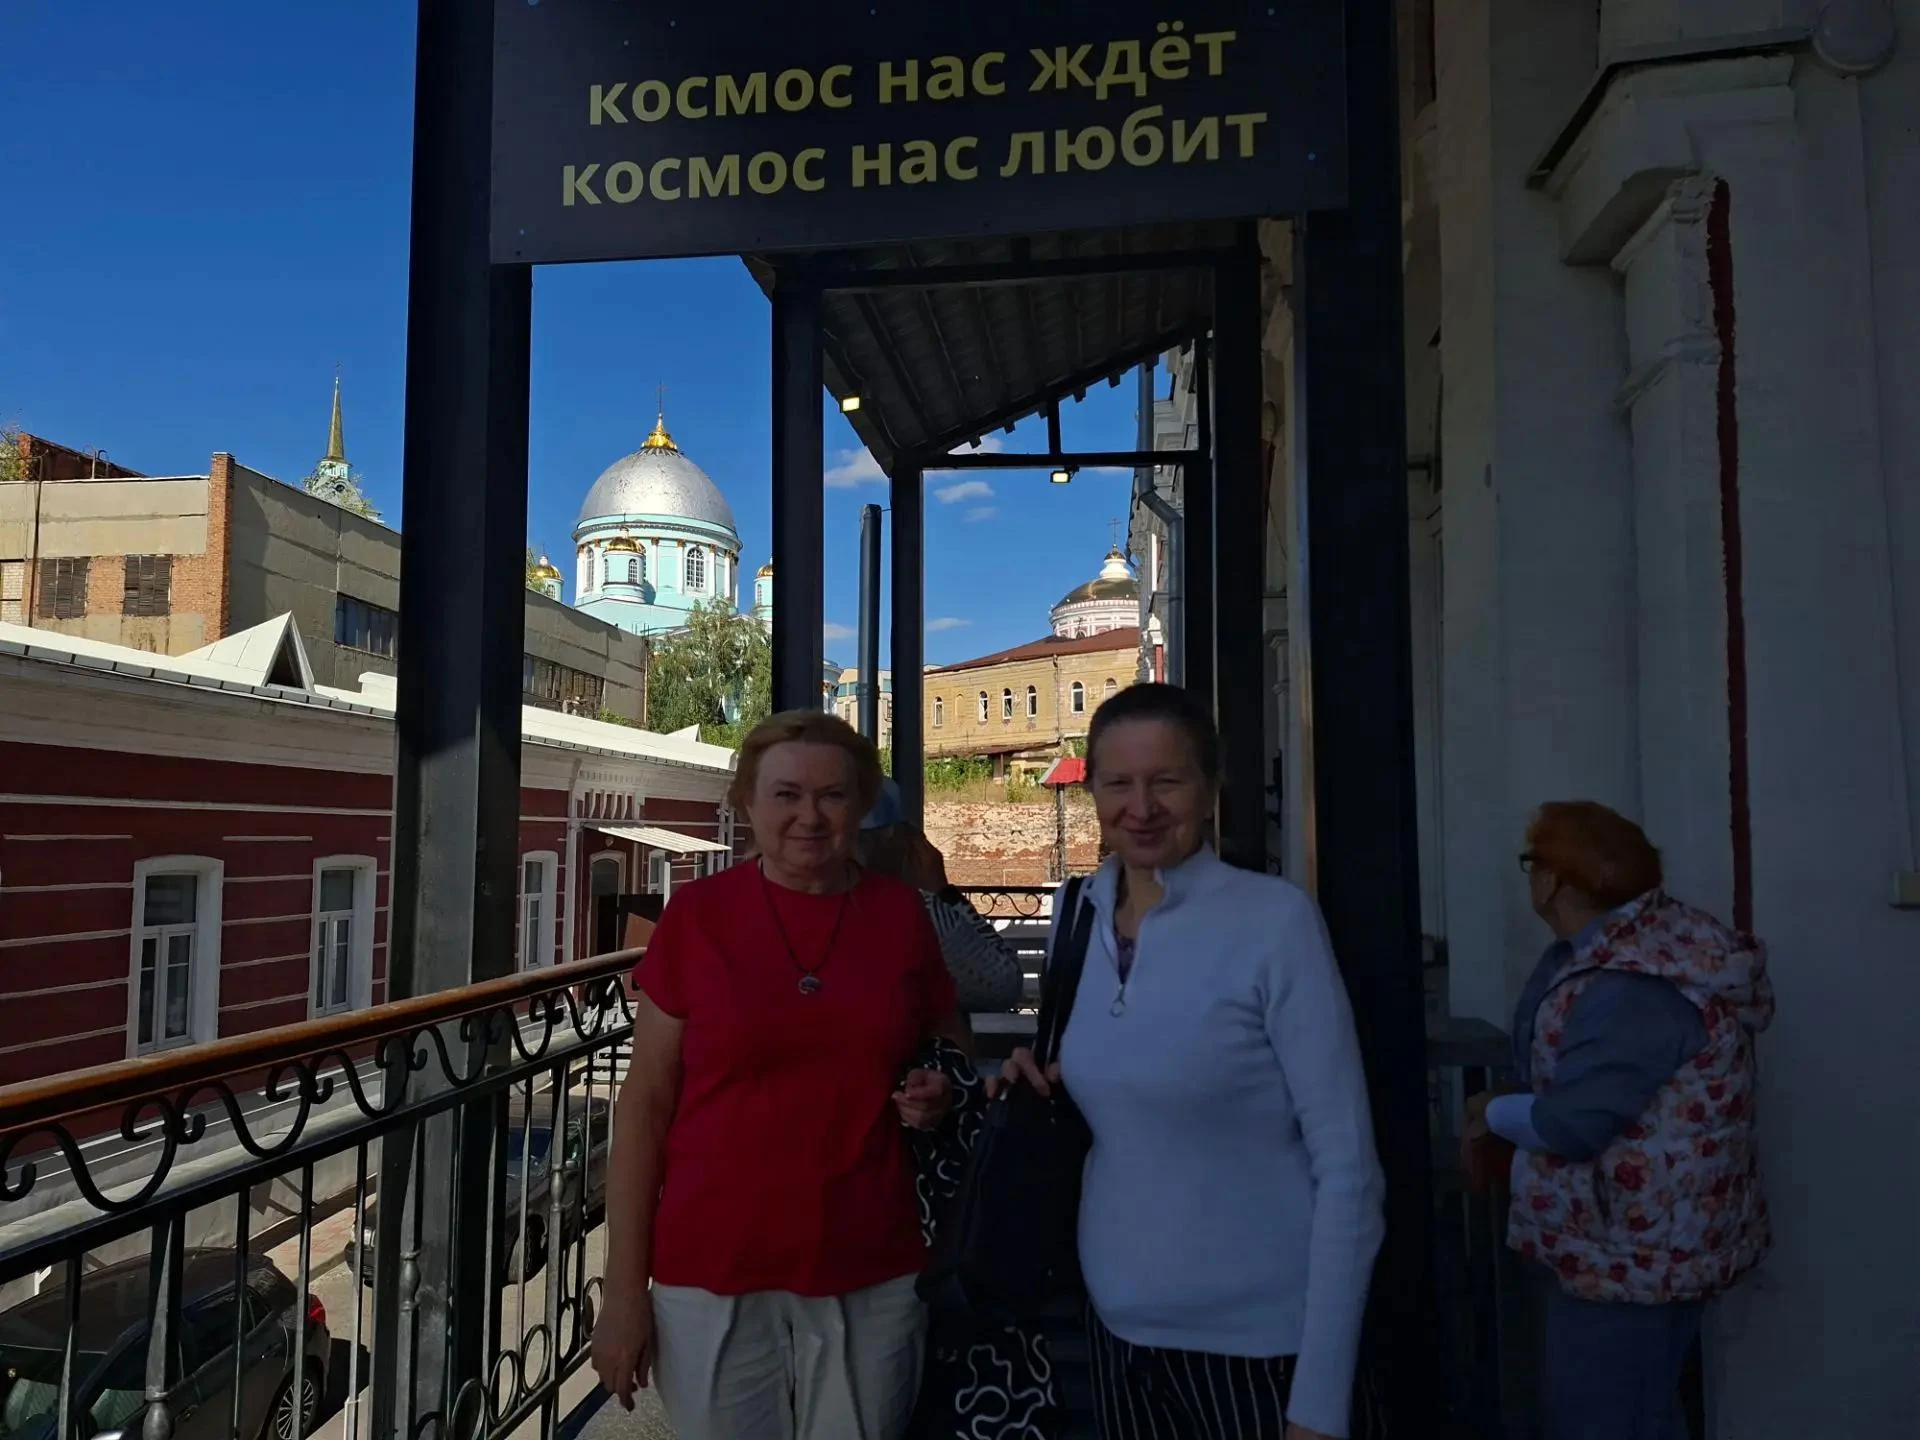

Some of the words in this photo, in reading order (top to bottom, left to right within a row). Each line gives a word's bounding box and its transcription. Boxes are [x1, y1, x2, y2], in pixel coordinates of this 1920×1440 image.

[589, 64, 853, 125] космос
[879, 51, 1006, 104] нас
[1028, 21, 1236, 98] ждёт
[562, 146, 825, 206] космос
[852, 137, 979, 188] нас
[1001, 106, 1266, 178] любит
